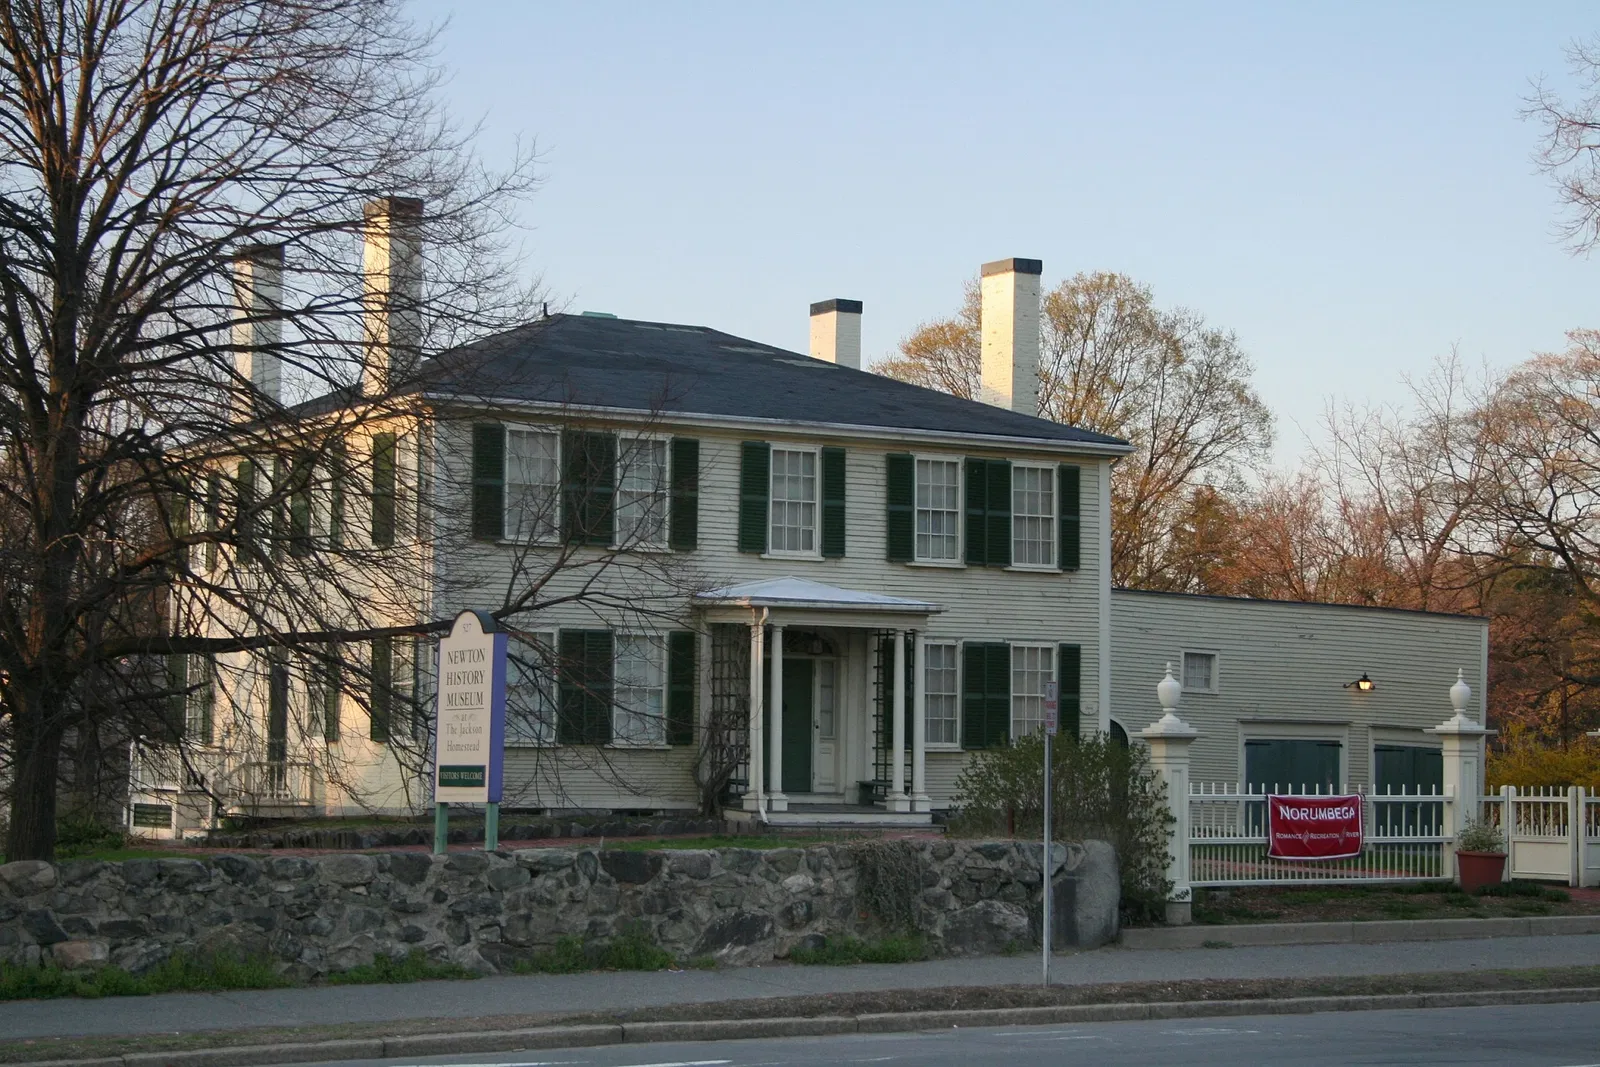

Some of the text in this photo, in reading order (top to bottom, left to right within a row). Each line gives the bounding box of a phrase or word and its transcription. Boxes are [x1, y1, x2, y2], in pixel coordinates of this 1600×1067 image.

[447, 648, 485, 664] NEWTON
[446, 670, 485, 686] HISTORY
[446, 691, 484, 707] MUSEUM
[461, 713, 468, 721] at
[446, 722, 483, 737] The Jackson
[446, 740, 480, 752] Homestead
[440, 771, 483, 780] VISITORS WELCOME
[1279, 806, 1355, 820] NORUMBEGA
[1275, 832, 1302, 840] ROMANCE
[1309, 832, 1340, 840] RECREATION
